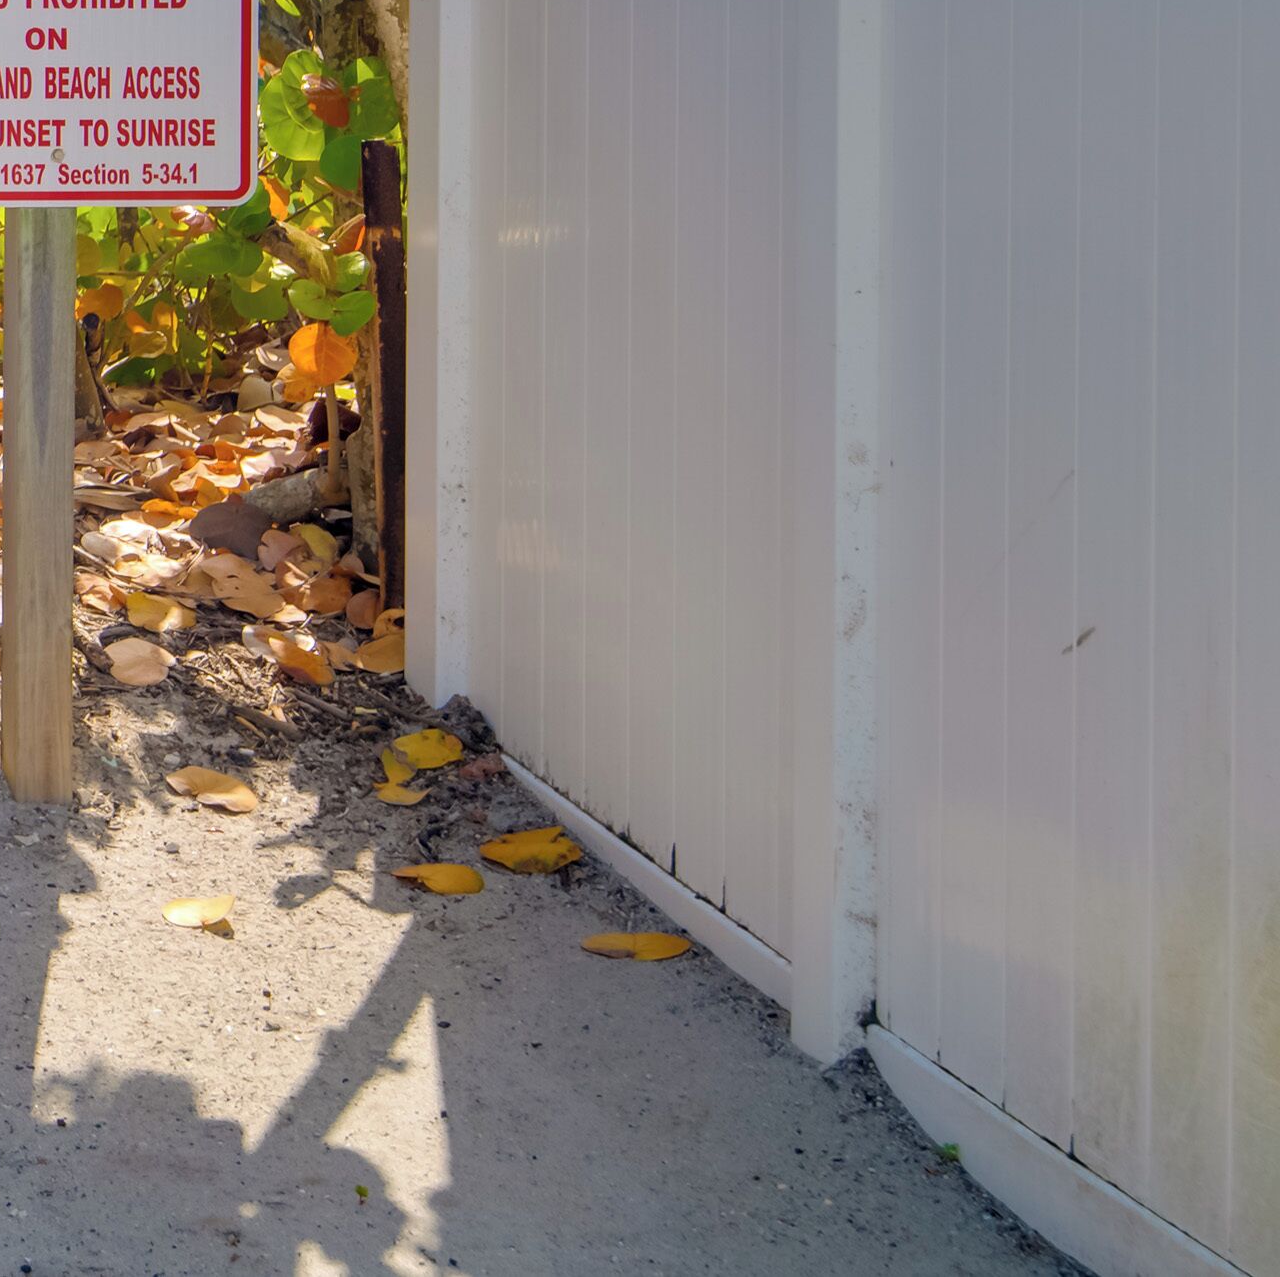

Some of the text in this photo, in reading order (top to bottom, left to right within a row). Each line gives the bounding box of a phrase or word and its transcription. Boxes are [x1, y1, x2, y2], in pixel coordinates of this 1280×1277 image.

[25, 27, 66, 49] ON
[45, 66, 109, 99] BEACH
[122, 66, 199, 98] ACCESS
[79, 119, 108, 146] TO
[117, 118, 215, 146] SUNRISE
[0, 164, 45, 184] 1637
[58, 163, 128, 184] Section
[142, 163, 196, 184] 5-34.1
